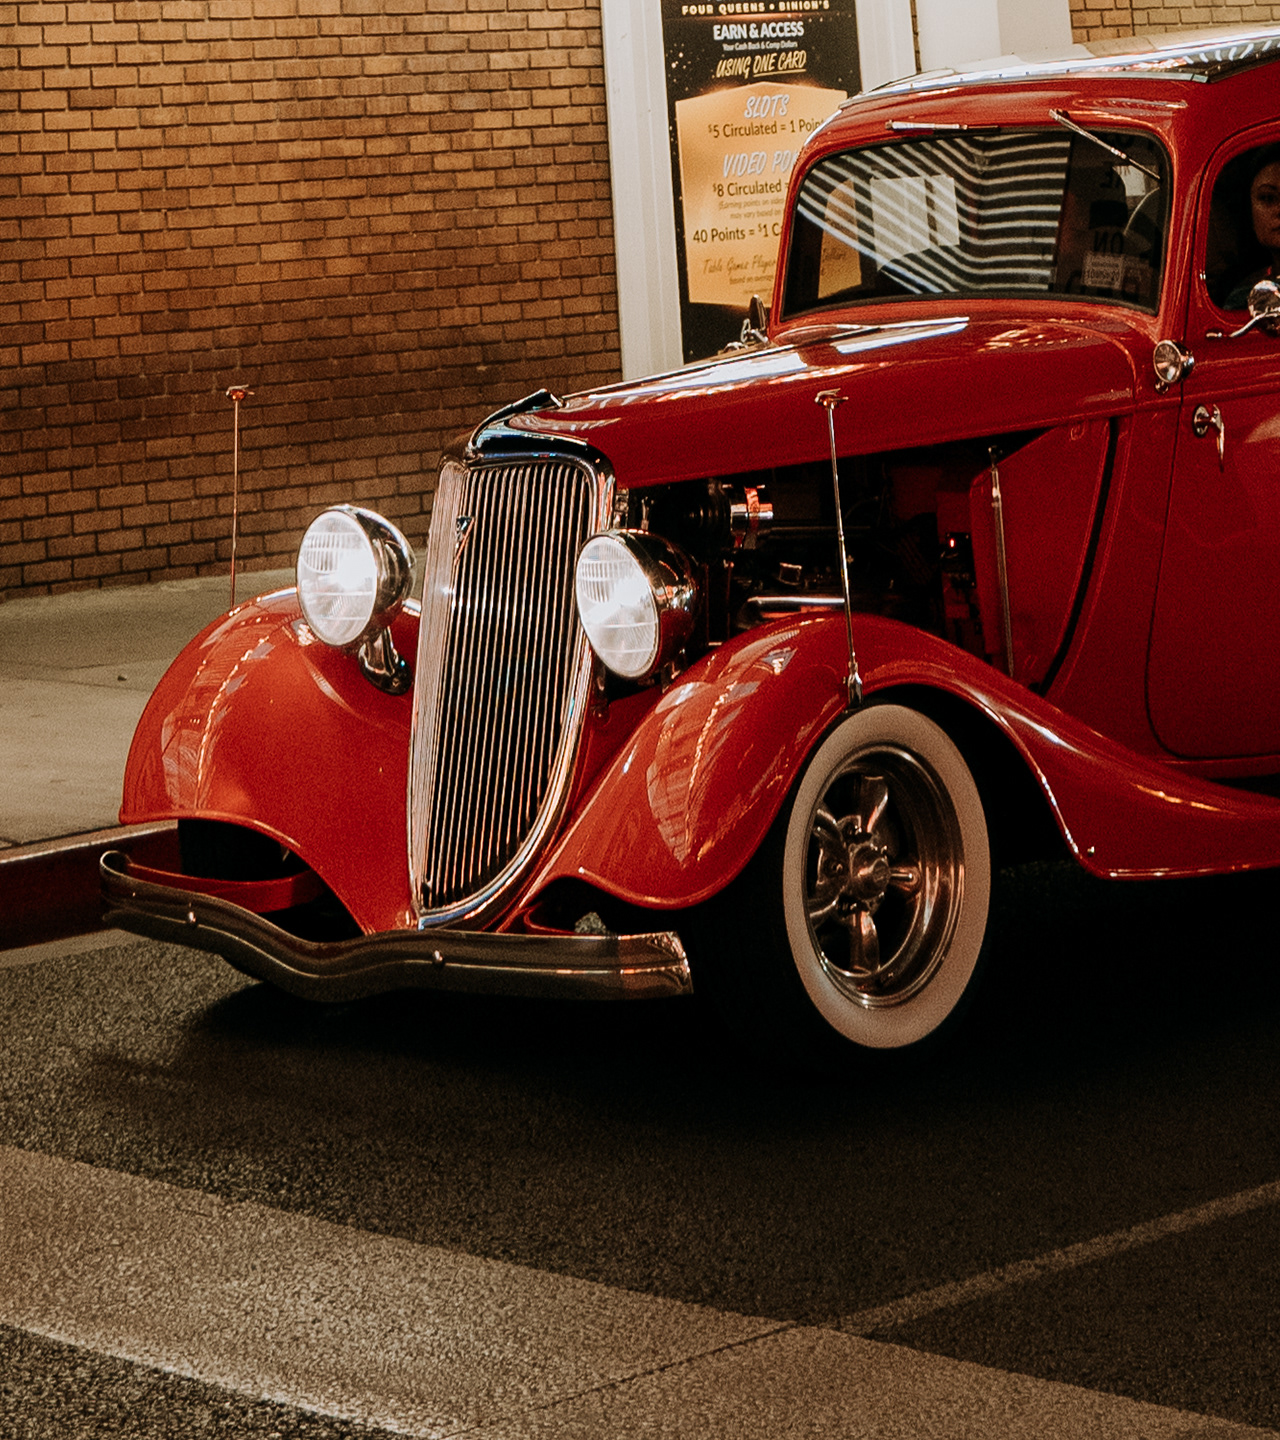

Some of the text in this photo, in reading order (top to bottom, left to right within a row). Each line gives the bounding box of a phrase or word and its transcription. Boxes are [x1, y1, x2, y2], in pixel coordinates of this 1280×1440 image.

[681, 0, 830, 16] FOUR QUEENS BINION'S
[713, 21, 805, 41] EARN & ACCESS
[734, 42, 747, 51] Cash
[747, 41, 760, 50] Back
[780, 39, 798, 48] Dollars
[715, 49, 807, 79] USING ONE CARD
[744, 94, 790, 119] SLOTS
[708, 123, 720, 139] $5
[722, 120, 778, 138] Circulated
[789, 119, 796, 133] 1
[723, 151, 767, 178] VIDEO
[712, 182, 725, 197] $8
[727, 179, 782, 196] Circulated
[693, 229, 708, 243] 40
[711, 227, 746, 242] Points
[757, 223, 769, 238] $1
